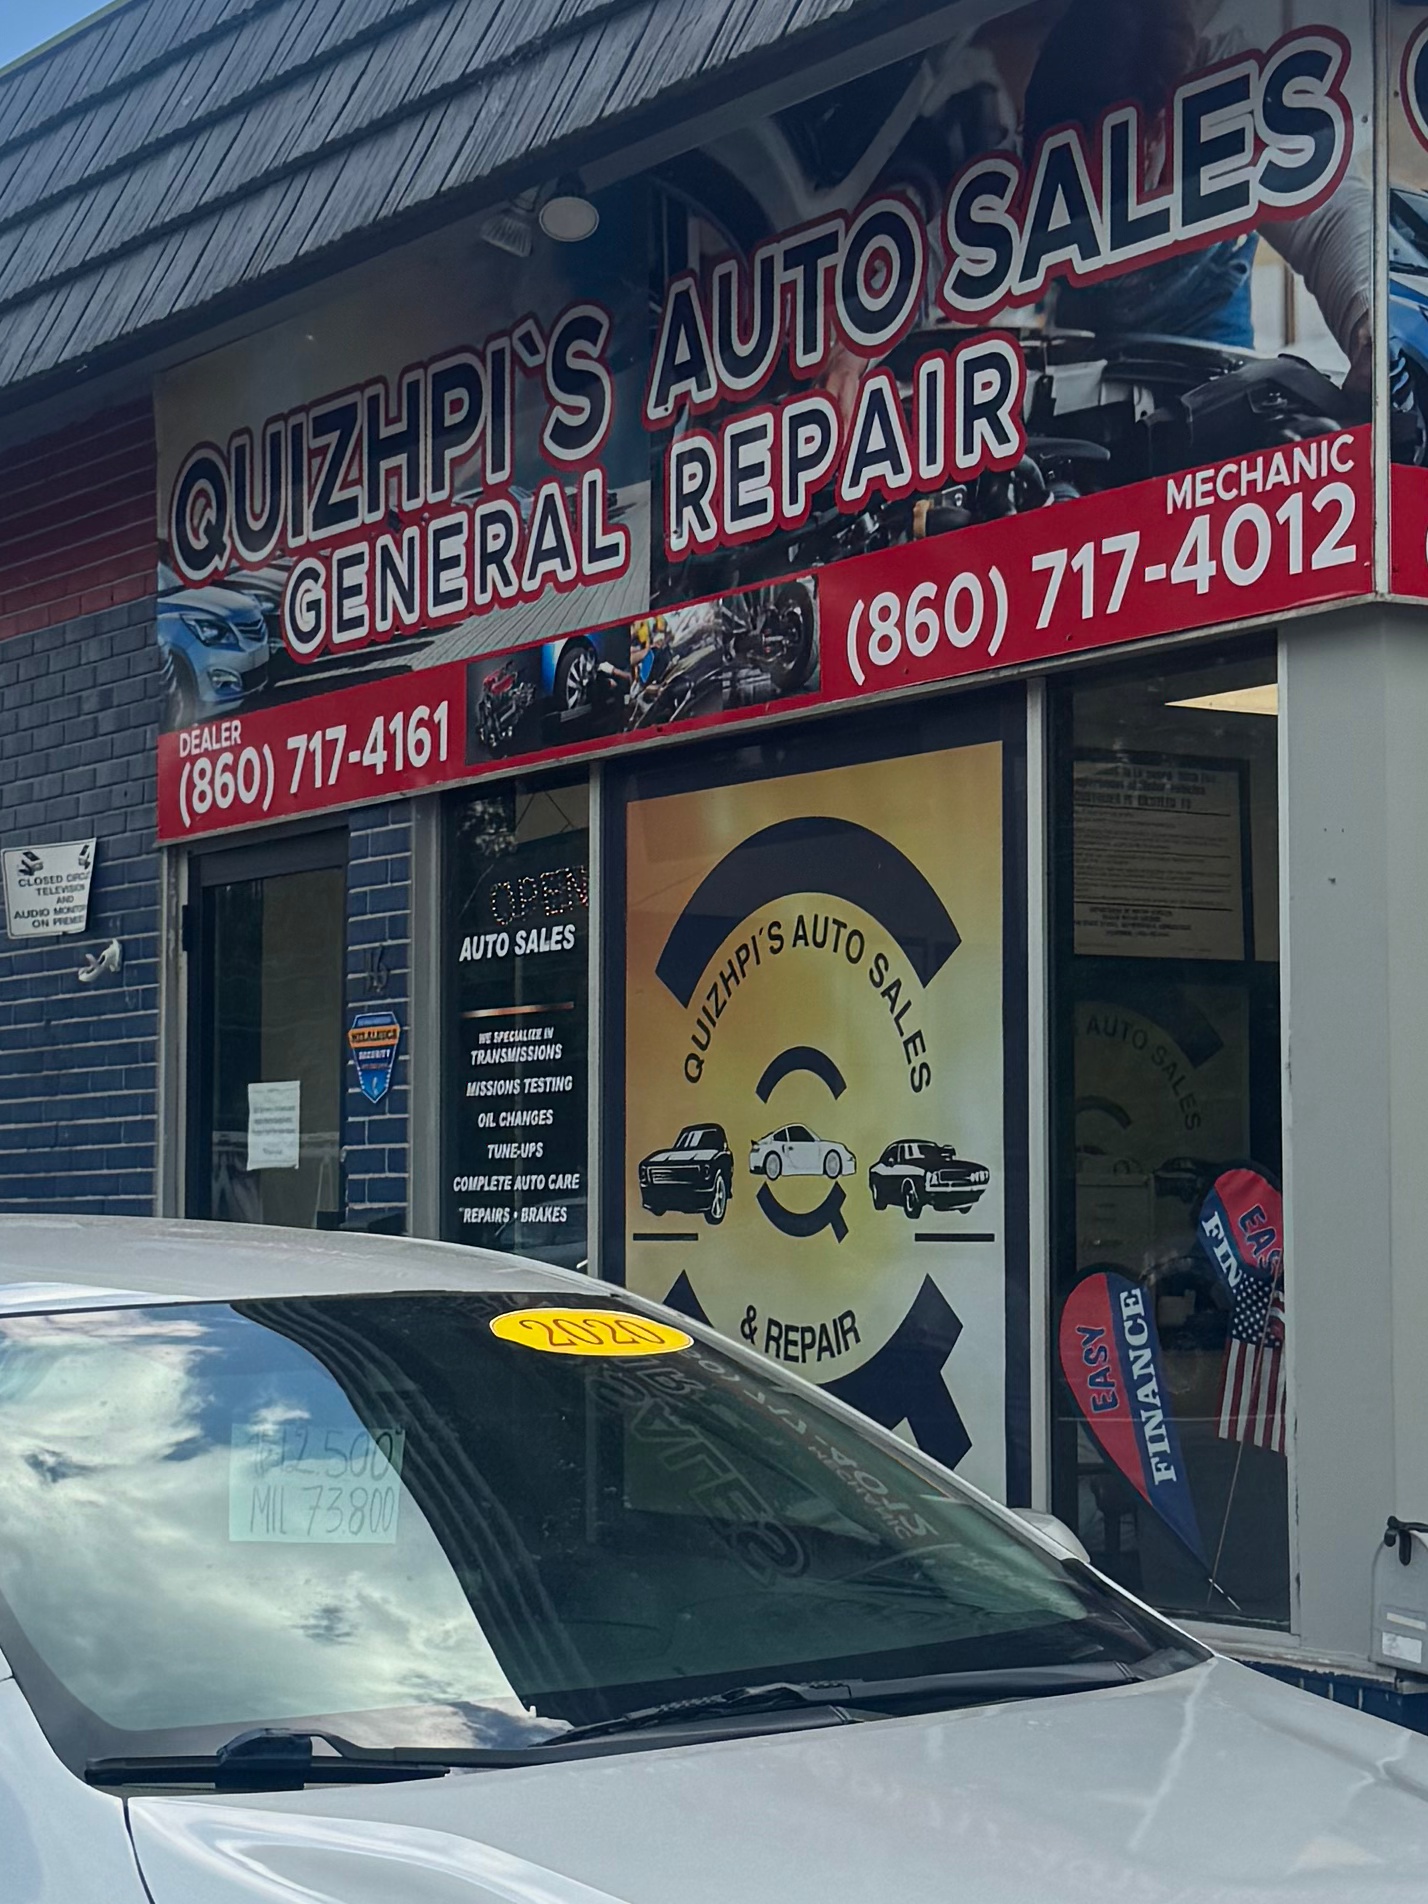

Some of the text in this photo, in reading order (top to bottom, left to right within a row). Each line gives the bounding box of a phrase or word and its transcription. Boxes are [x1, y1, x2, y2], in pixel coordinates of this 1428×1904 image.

[646, 197, 923, 430] AUTO
[945, 27, 1350, 320] SALES
[283, 333, 1026, 662] GENERAL REPAIR
[1167, 432, 1354, 517] MECHANIC
[846, 479, 1357, 686] (860) 717-4012
[179, 721, 241, 758] DEALER
[179, 701, 448, 826] (860) 717-4161
[18, 875, 63, 887] CLOSED
[491, 865, 588, 926] OPEN
[14, 908, 49, 919] AUDIO
[32, 920, 49, 928] ON
[459, 924, 575, 962] AUTO SALES
[792, 915, 866, 967] AUTO
[869, 952, 932, 1094] SALES
[471, 1044, 562, 1065] TRANSMISSIONS
[1086, 1015, 1201, 1131] AUTO SALES
[524, 1076, 572, 1093] TESTING
[478, 1109, 553, 1127] OIL CHANGES
[487, 1142, 543, 1159] TUNE-UPS
[453, 1174, 580, 1191] COMPLETE AUTO CARE
[463, 1207, 567, 1223] REPAIRS BRAKES
[1238, 1204, 1283, 1274] EAS
[519, 1318, 666, 1346] 2020
[741, 1305, 758, 1344] &
[764, 1309, 861, 1365] REPAIR
[1076, 1325, 1119, 1413] EASY
[1120, 1288, 1177, 1486] FINANCE
[250, 1484, 395, 1536] MIL 73.800
